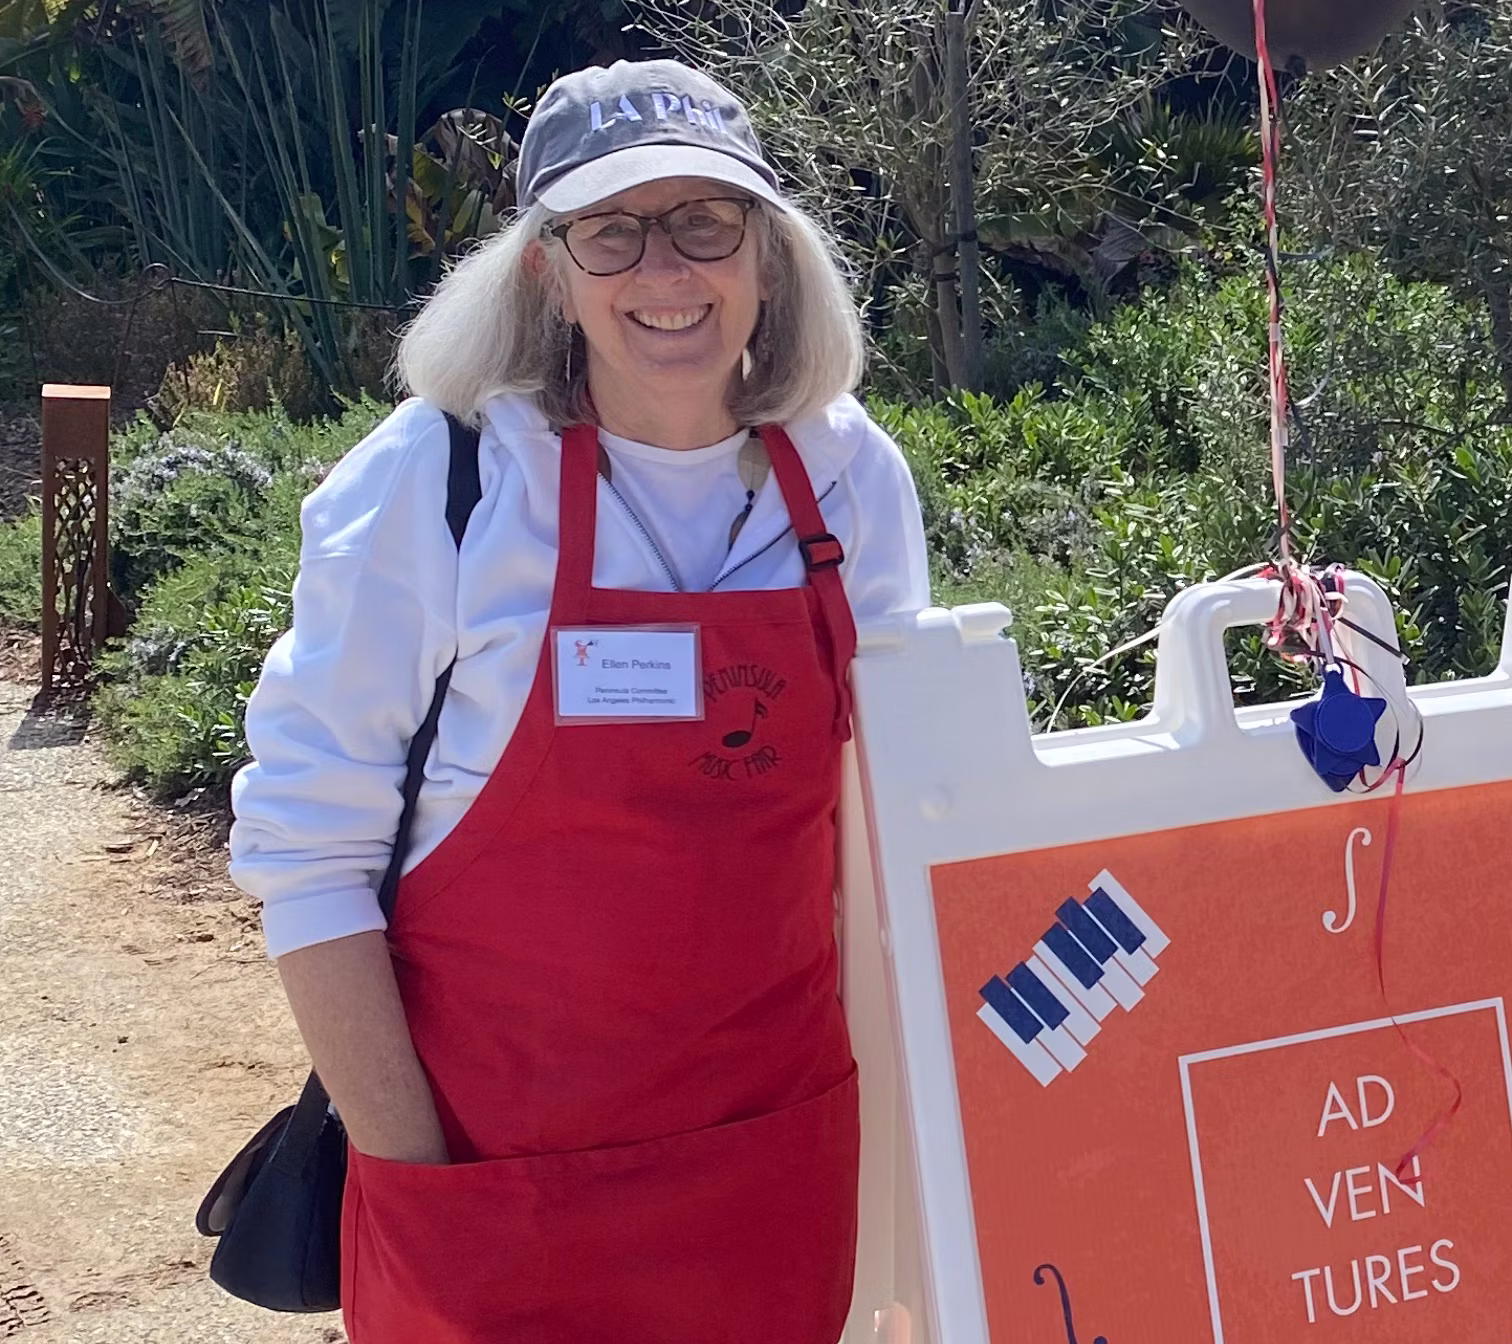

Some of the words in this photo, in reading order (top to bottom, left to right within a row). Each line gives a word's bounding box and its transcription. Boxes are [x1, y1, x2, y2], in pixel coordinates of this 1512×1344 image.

[590, 94, 643, 131] LA
[651, 92, 729, 135] Phil
[601, 659, 629, 669] Ellen
[631, 659, 671, 670] Perkins
[688, 751, 740, 781] MUSIC
[1317, 1074, 1395, 1137] AD
[1303, 1155, 1426, 1229] VEN
[1291, 1238, 1461, 1323] TURES
